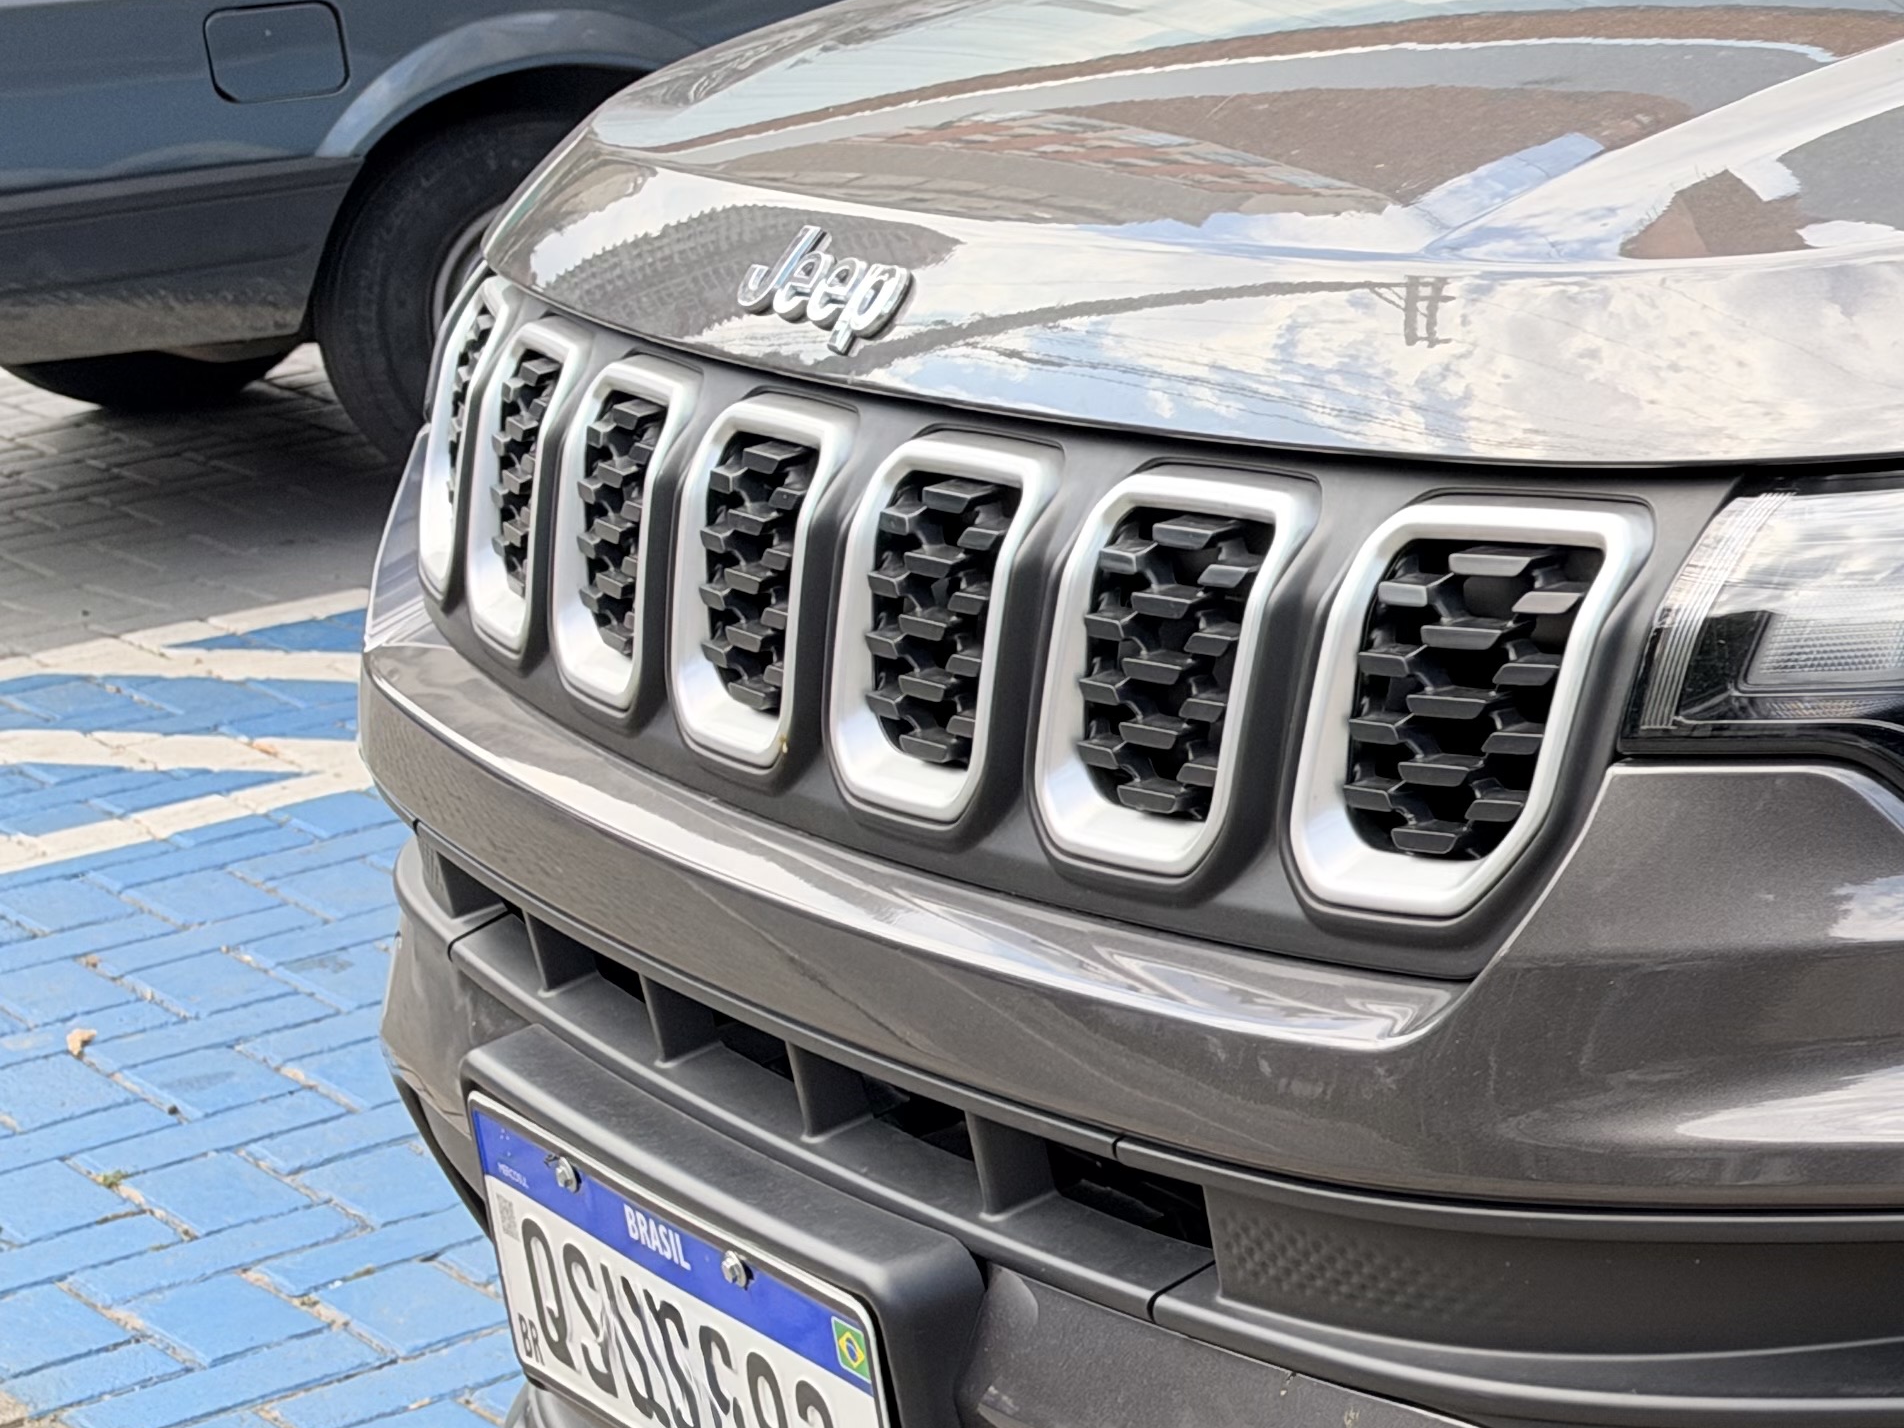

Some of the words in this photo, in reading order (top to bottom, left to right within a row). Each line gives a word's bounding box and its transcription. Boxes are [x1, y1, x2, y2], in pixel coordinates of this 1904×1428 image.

[737, 225, 913, 354] Jeep
[623, 1204, 691, 1271] BRASIL
[518, 1312, 545, 1366] BR
